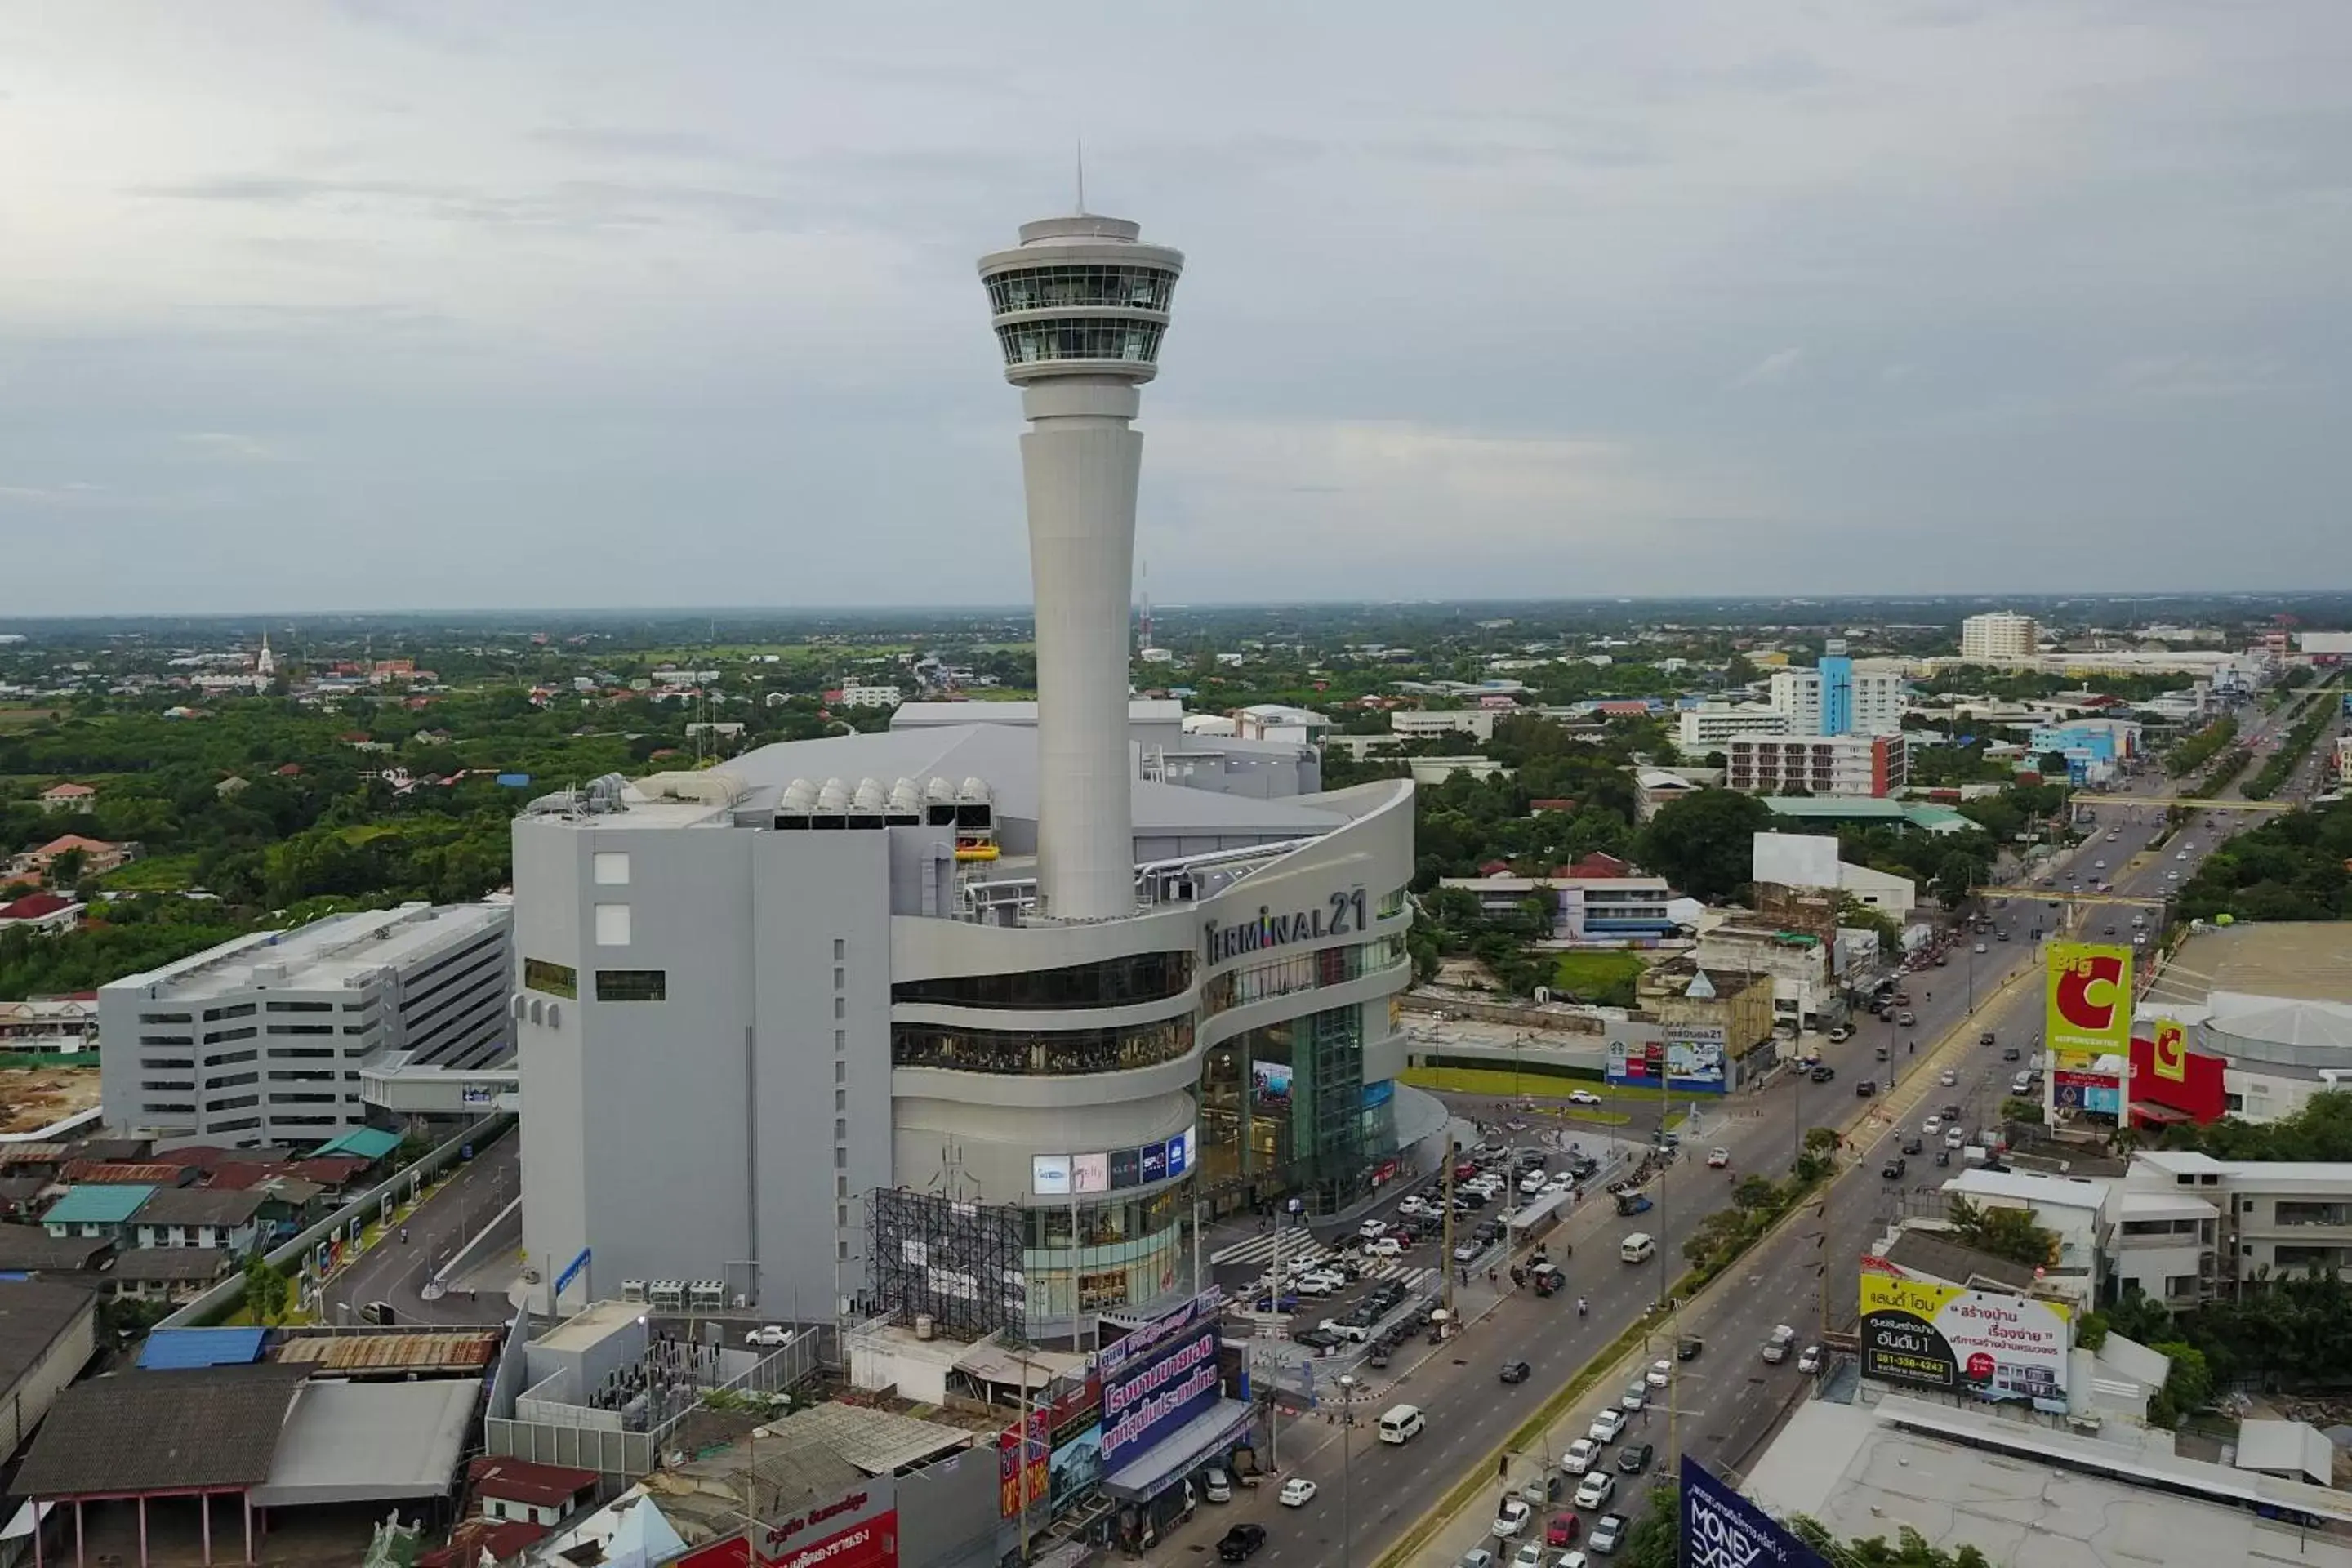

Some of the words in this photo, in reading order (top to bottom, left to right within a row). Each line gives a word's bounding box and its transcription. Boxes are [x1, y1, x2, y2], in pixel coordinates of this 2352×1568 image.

[1961, 1306, 2018, 1322] สร้างบ้าน
[1877, 1331, 1920, 1351] อันดับ
[1988, 1323, 2041, 1342] เรื่องง่าย
[1102, 1364, 1218, 1460] ถูกที่สุดในประเทศไทย
[1691, 1498, 1761, 1566] MONEY
[1691, 1527, 1745, 1568] EXP
